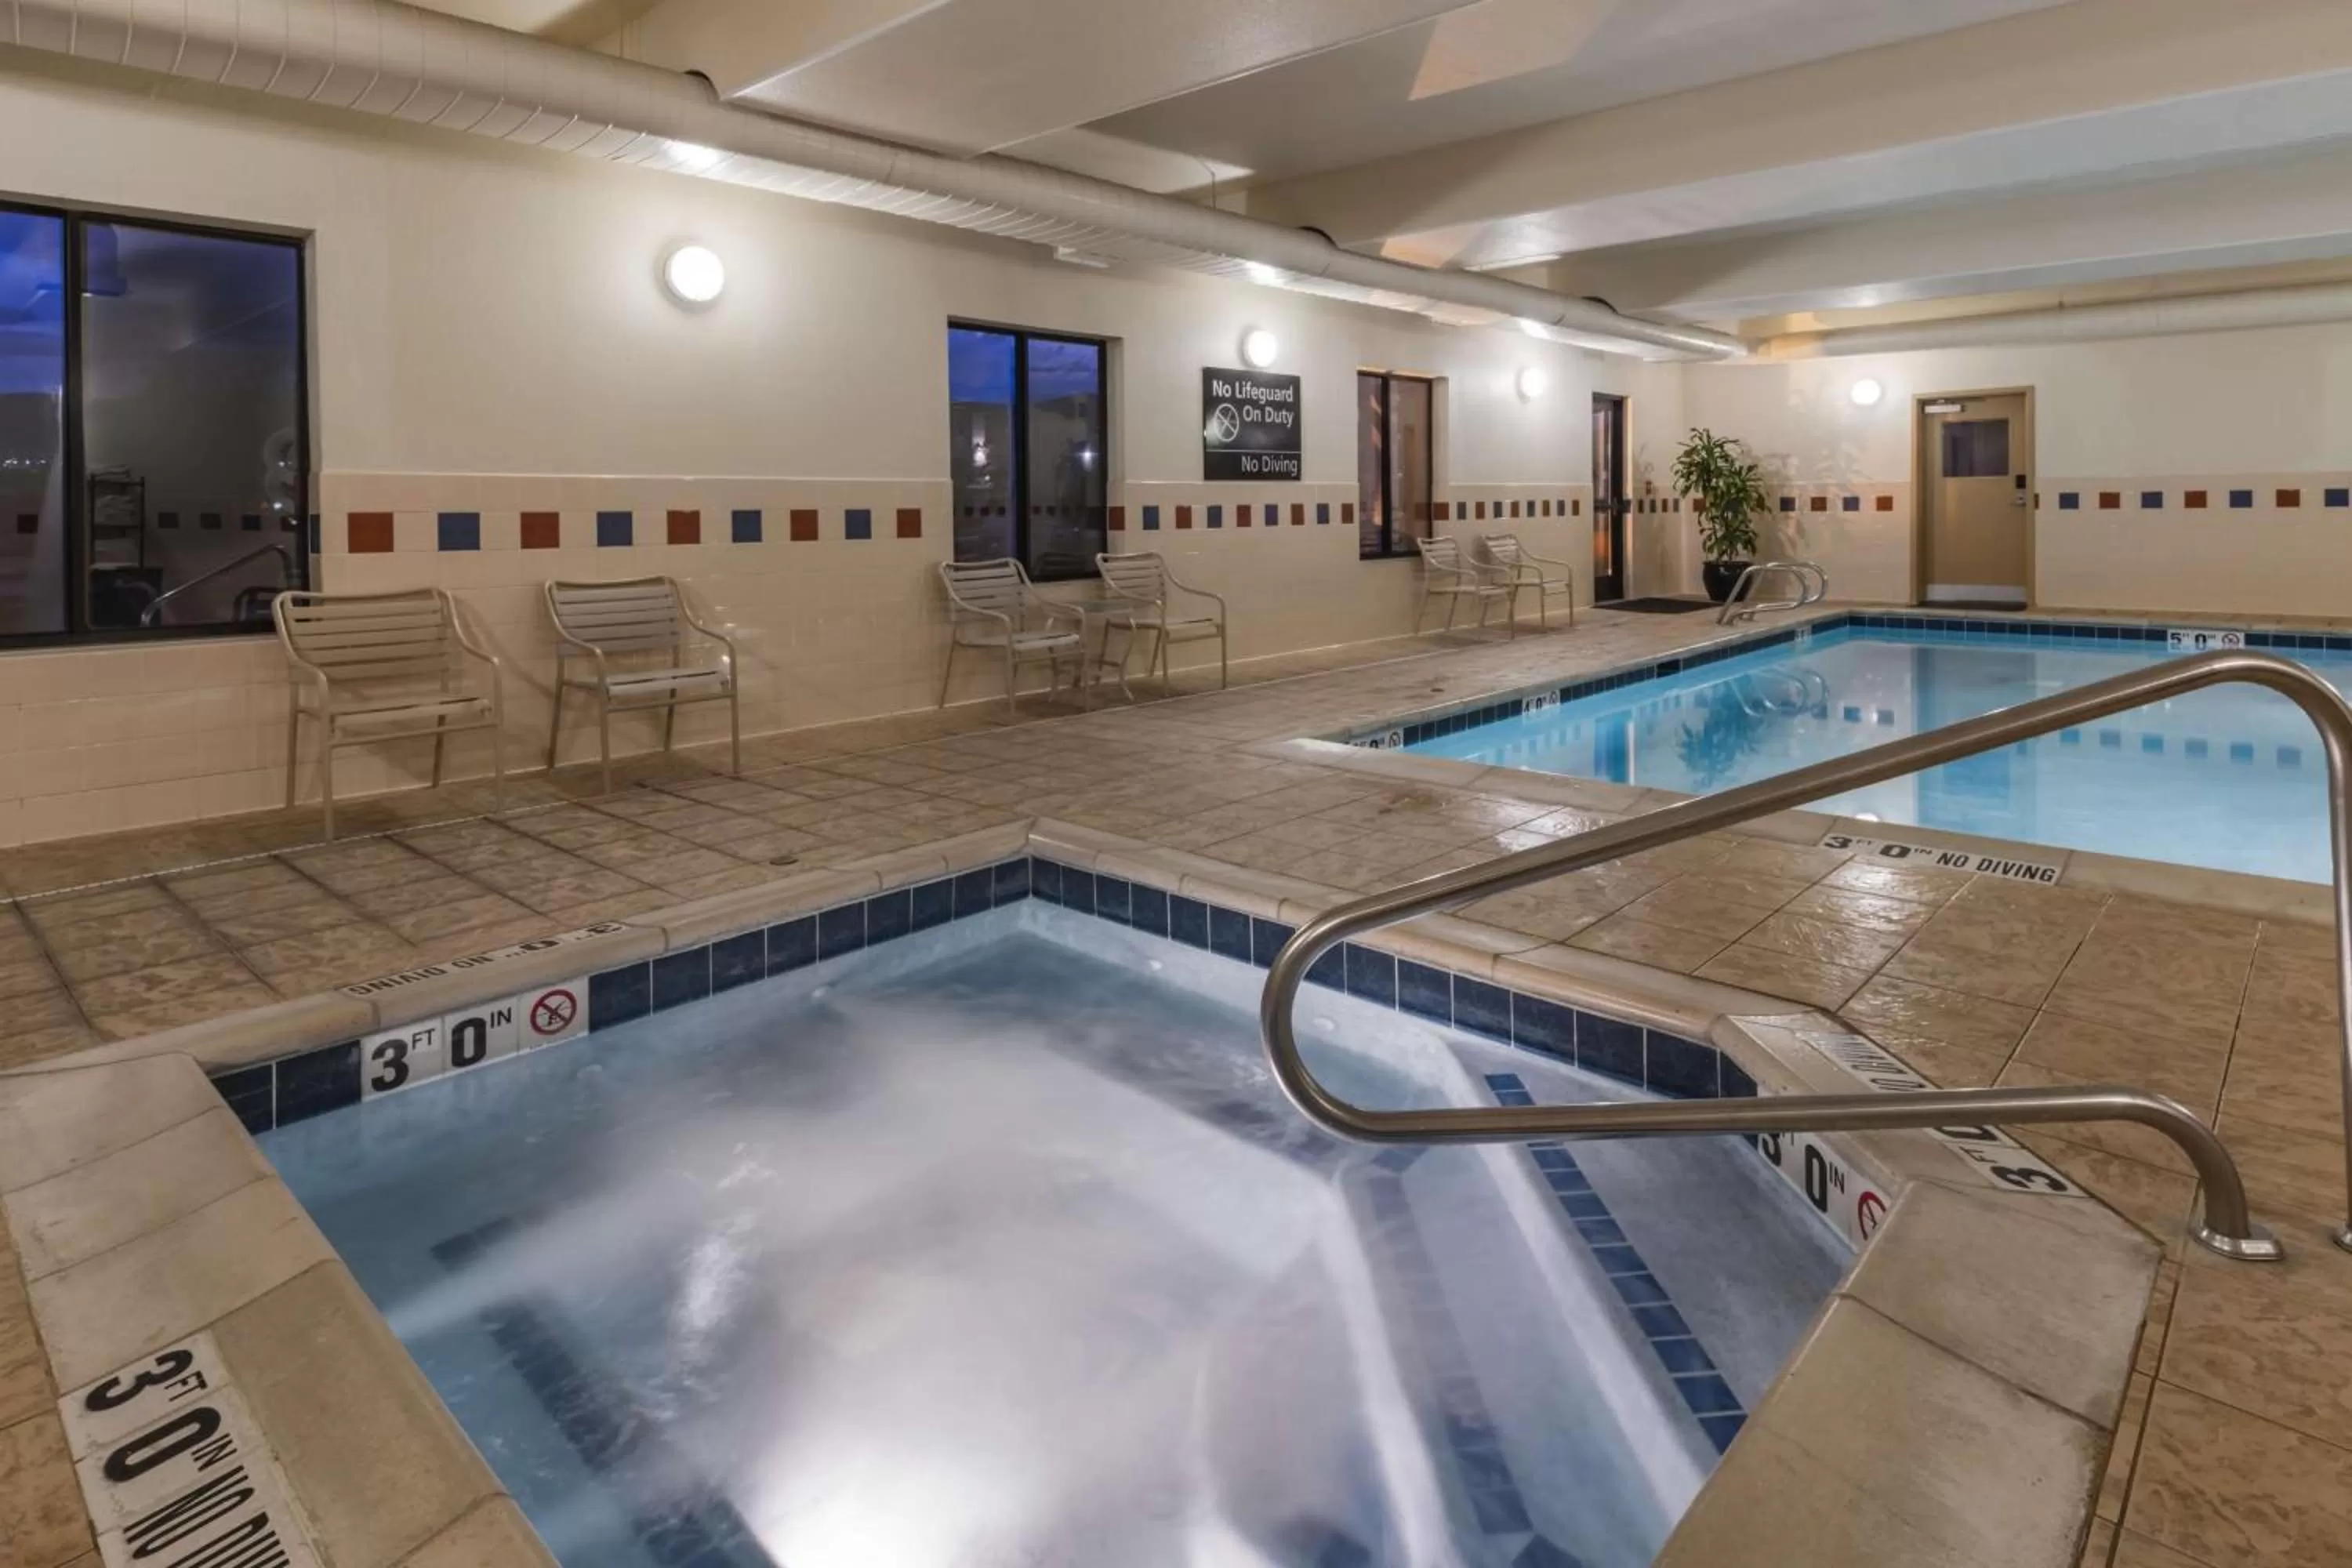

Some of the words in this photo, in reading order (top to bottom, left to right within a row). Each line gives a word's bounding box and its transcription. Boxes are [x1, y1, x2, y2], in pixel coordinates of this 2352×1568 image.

[1212, 379, 1232, 397] No
[1235, 381, 1293, 405] Lifeguard
[1243, 405, 1261, 423] On
[1265, 406, 1294, 429] Duty
[1241, 455, 1258, 473] No
[1262, 455, 1298, 477] Diving
[1824, 837, 1853, 849] 3
[1879, 844, 1911, 858] 0
[1936, 852, 1969, 869] NO
[1976, 858, 2056, 883] DIVING
[451, 956, 494, 969] NO
[348, 965, 448, 996] DIVING
[371, 1039, 409, 1092] 3
[412, 1028, 436, 1051] FT
[452, 1017, 487, 1067] 0
[490, 1007, 512, 1029] IN
[1959, 1146, 1998, 1163] FT
[1829, 1161, 1845, 1195] IN
[1990, 1165, 2068, 1192] 3
[85, 1349, 193, 1411] 3
[165, 1370, 209, 1402] FT
[103, 1406, 221, 1483] 0
[191, 1433, 237, 1472] IN
[123, 1465, 256, 1558] NO
